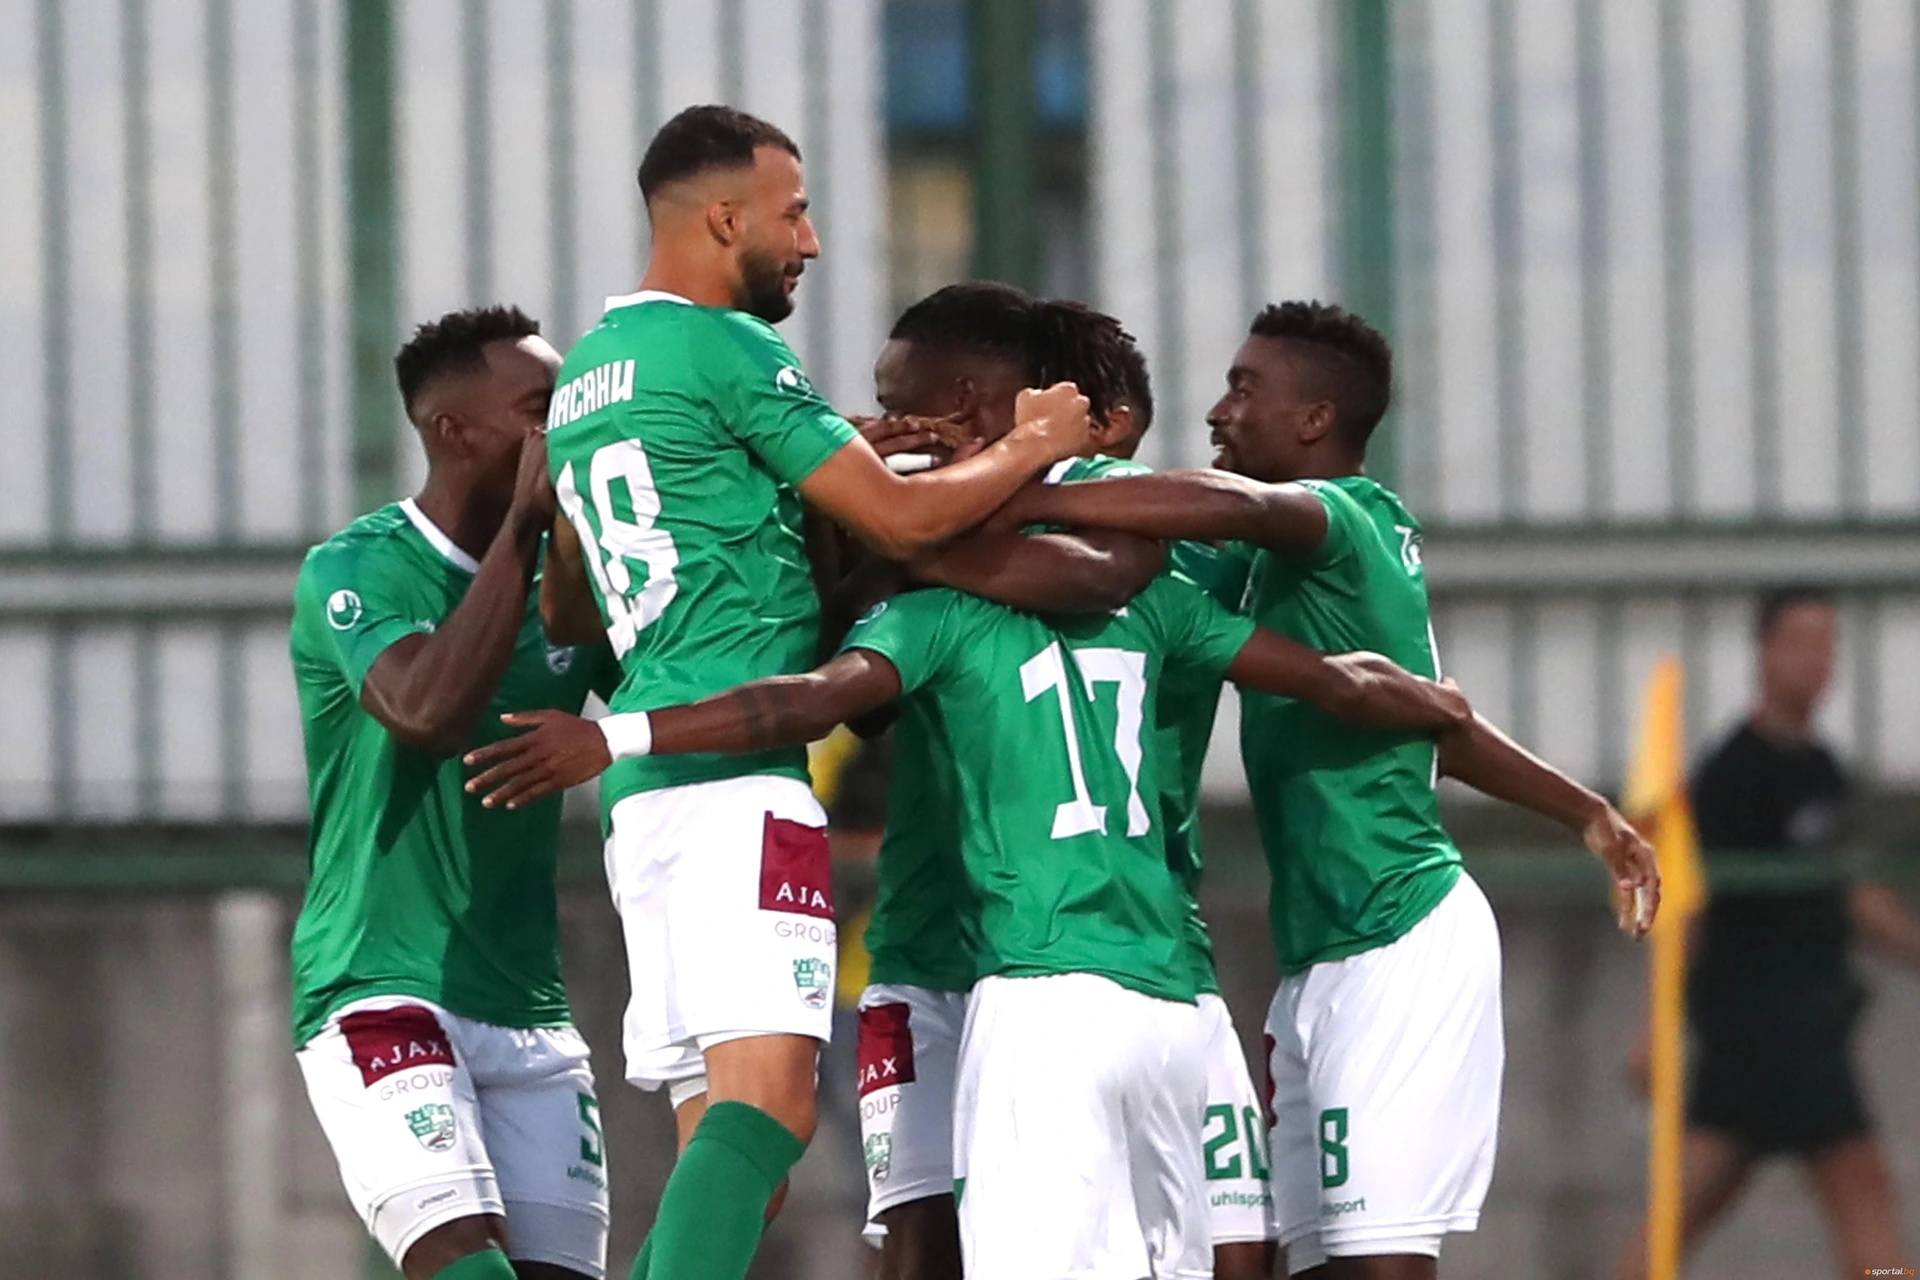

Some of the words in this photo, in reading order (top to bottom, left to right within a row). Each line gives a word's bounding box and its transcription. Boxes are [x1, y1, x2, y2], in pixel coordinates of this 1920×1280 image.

[556, 438, 680, 661] 18
[1019, 640, 1151, 840] 17
[775, 881, 835, 913] AJA
[370, 1039, 445, 1072] AJAX
[857, 1056, 898, 1091] JAX
[380, 1070, 455, 1101] GROUP
[860, 1093, 902, 1120] OUP
[577, 1091, 603, 1167] 5
[1203, 1103, 1271, 1181] 20
[1320, 1107, 1349, 1189] 8
